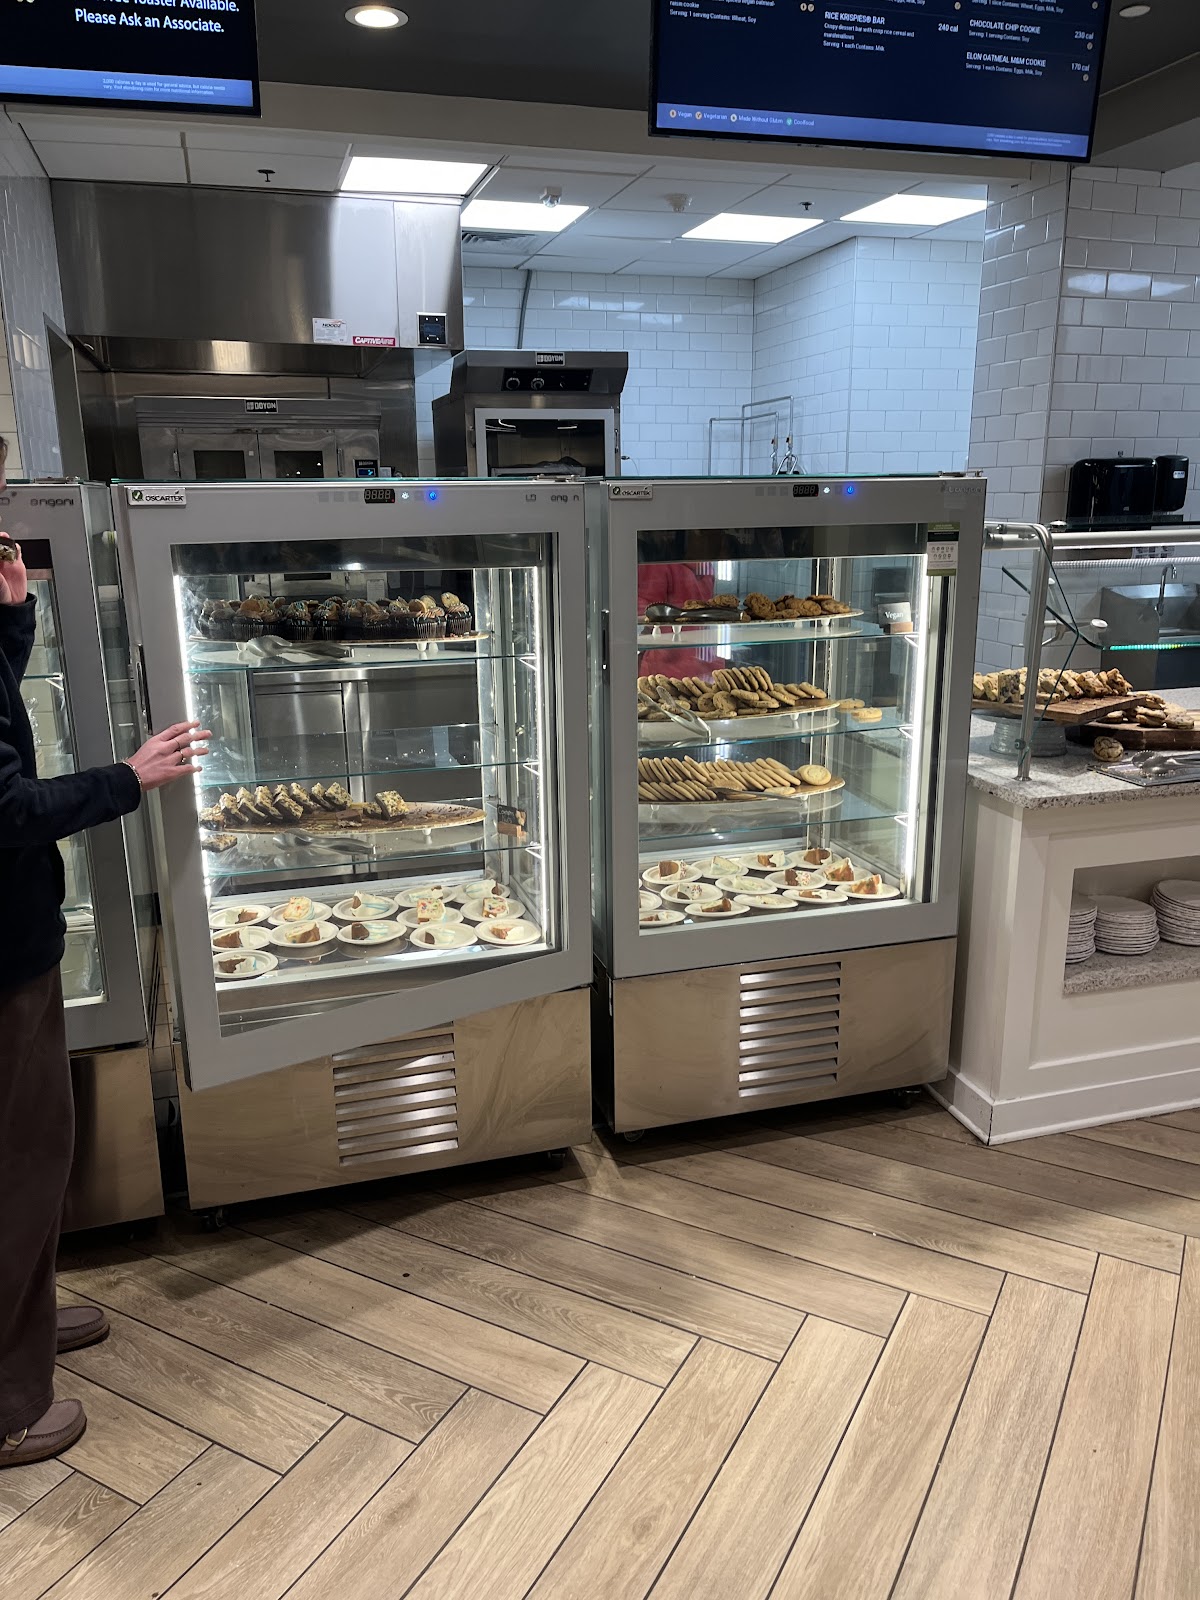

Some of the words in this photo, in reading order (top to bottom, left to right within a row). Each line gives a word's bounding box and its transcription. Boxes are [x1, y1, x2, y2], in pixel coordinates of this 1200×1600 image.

[180, 0, 239, 12] Available.
[75, 9, 116, 25] Please
[119, 12, 142, 27] Ask
[144, 17, 160, 28] an
[163, 16, 224, 33] Associate.
[824, 11, 839, 21] RICE
[872, 16, 885, 25] BAR
[938, 23, 949, 32] 240
[949, 24, 959, 32] cal
[970, 19, 1004, 31] CHOCOLATE
[1005, 23, 1019, 32] CHIP
[1020, 25, 1041, 34] COOKIE
[1085, 32, 1094, 40] cal
[966, 51, 982, 61] ELON
[983, 53, 1009, 64] OATMEAL
[1025, 58, 1046, 67] COOKIE
[1081, 64, 1090, 72] cal
[678, 110, 692, 119] Vegan
[703, 112, 728, 121] Vegetarian
[885, 611, 903, 620] Vegan
